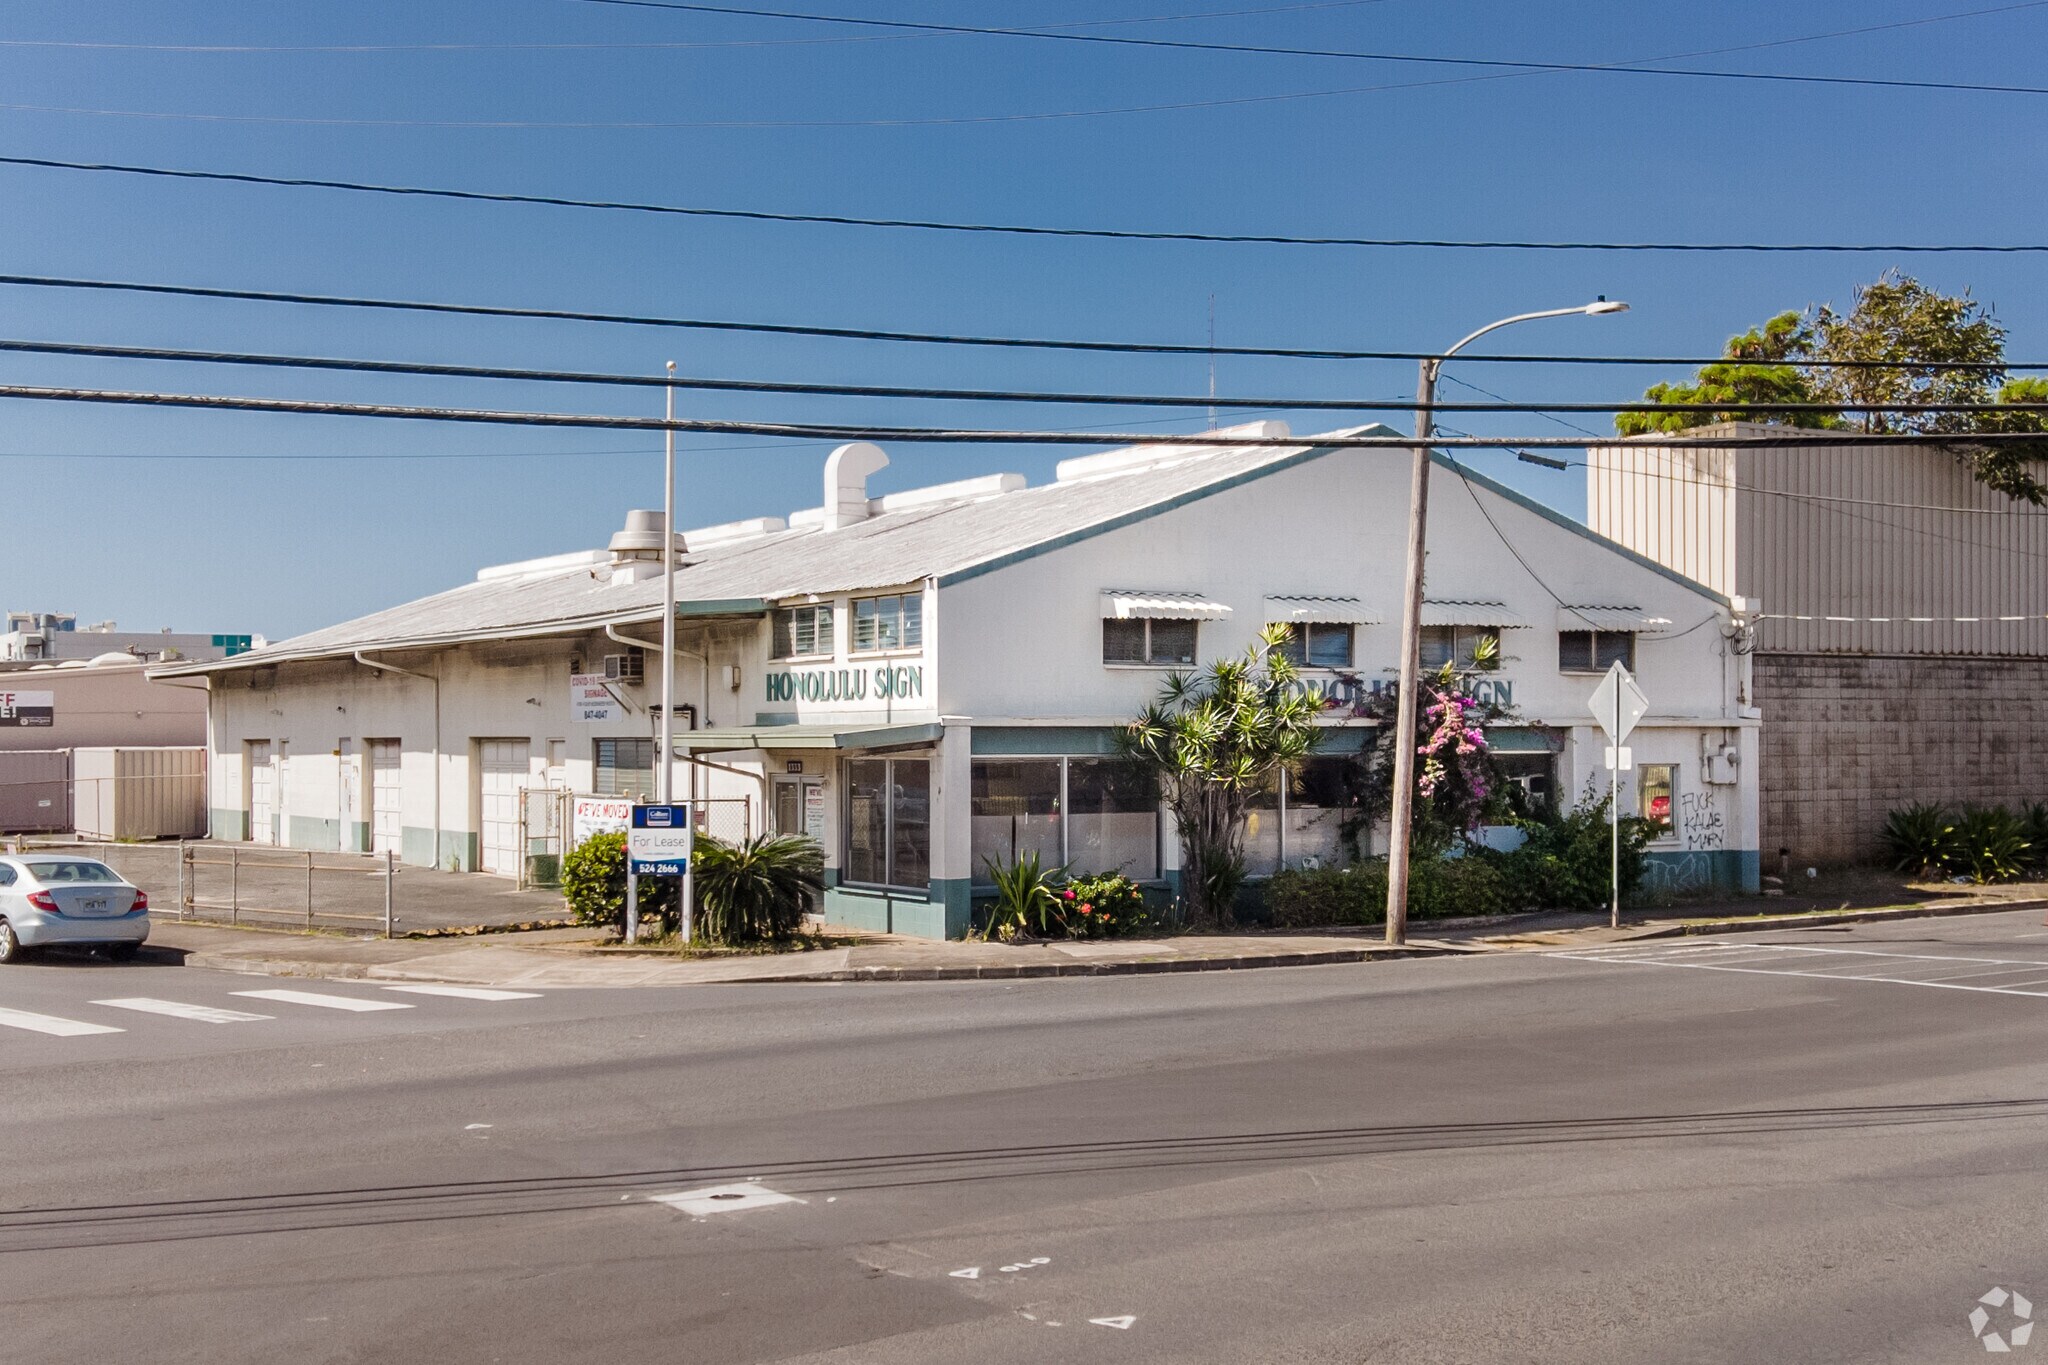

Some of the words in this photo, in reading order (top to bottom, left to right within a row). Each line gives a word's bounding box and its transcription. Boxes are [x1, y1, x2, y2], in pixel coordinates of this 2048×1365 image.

[766, 669, 866, 702] HONOLULU
[874, 665, 923, 700] SIGN
[1445, 677, 1513, 708] IGN
[603, 804, 629, 819] MOVED
[1682, 792, 1714, 816] FUCK
[633, 835, 651, 848] For
[654, 835, 685, 848] Lease
[639, 863, 655, 873] 524
[656, 863, 679, 873] 2666
